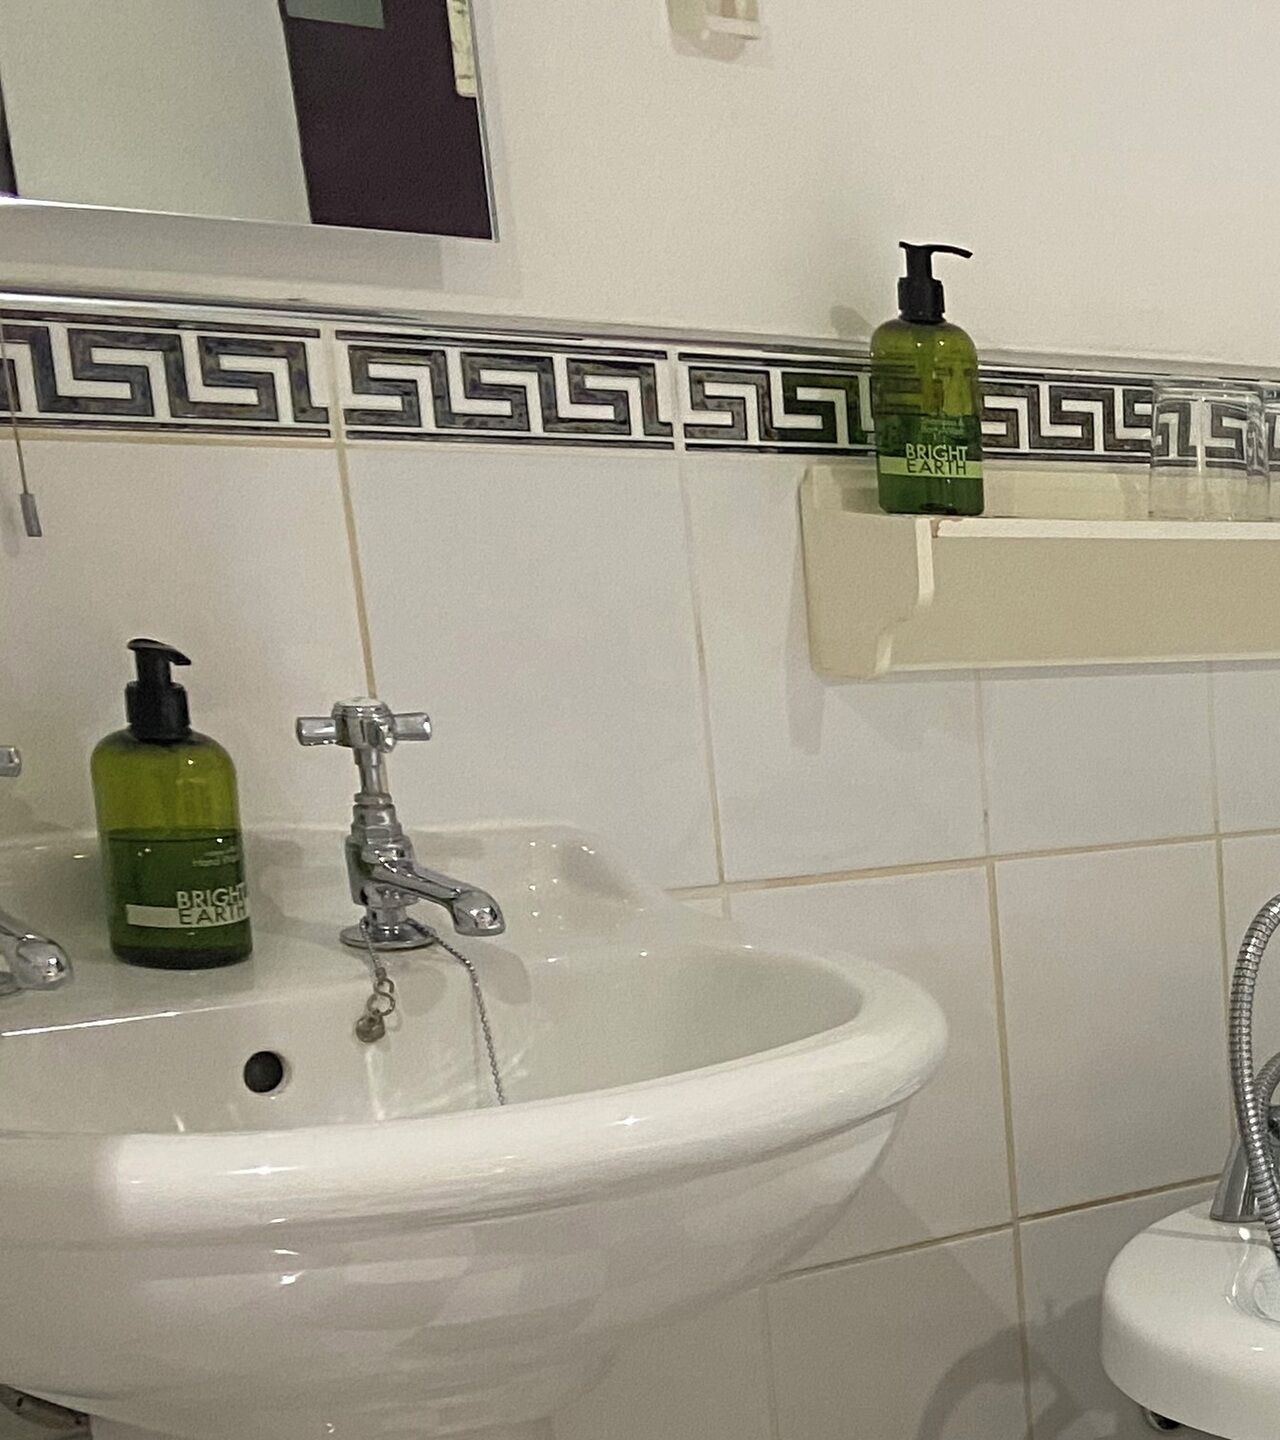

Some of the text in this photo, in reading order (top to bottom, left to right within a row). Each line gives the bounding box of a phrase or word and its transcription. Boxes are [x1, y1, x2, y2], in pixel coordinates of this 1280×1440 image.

[906, 443, 968, 461] BRIGHT
[907, 459, 966, 475] EARTH
[177, 882, 245, 908] BRIGHT
[179, 902, 246, 925] EARTH
